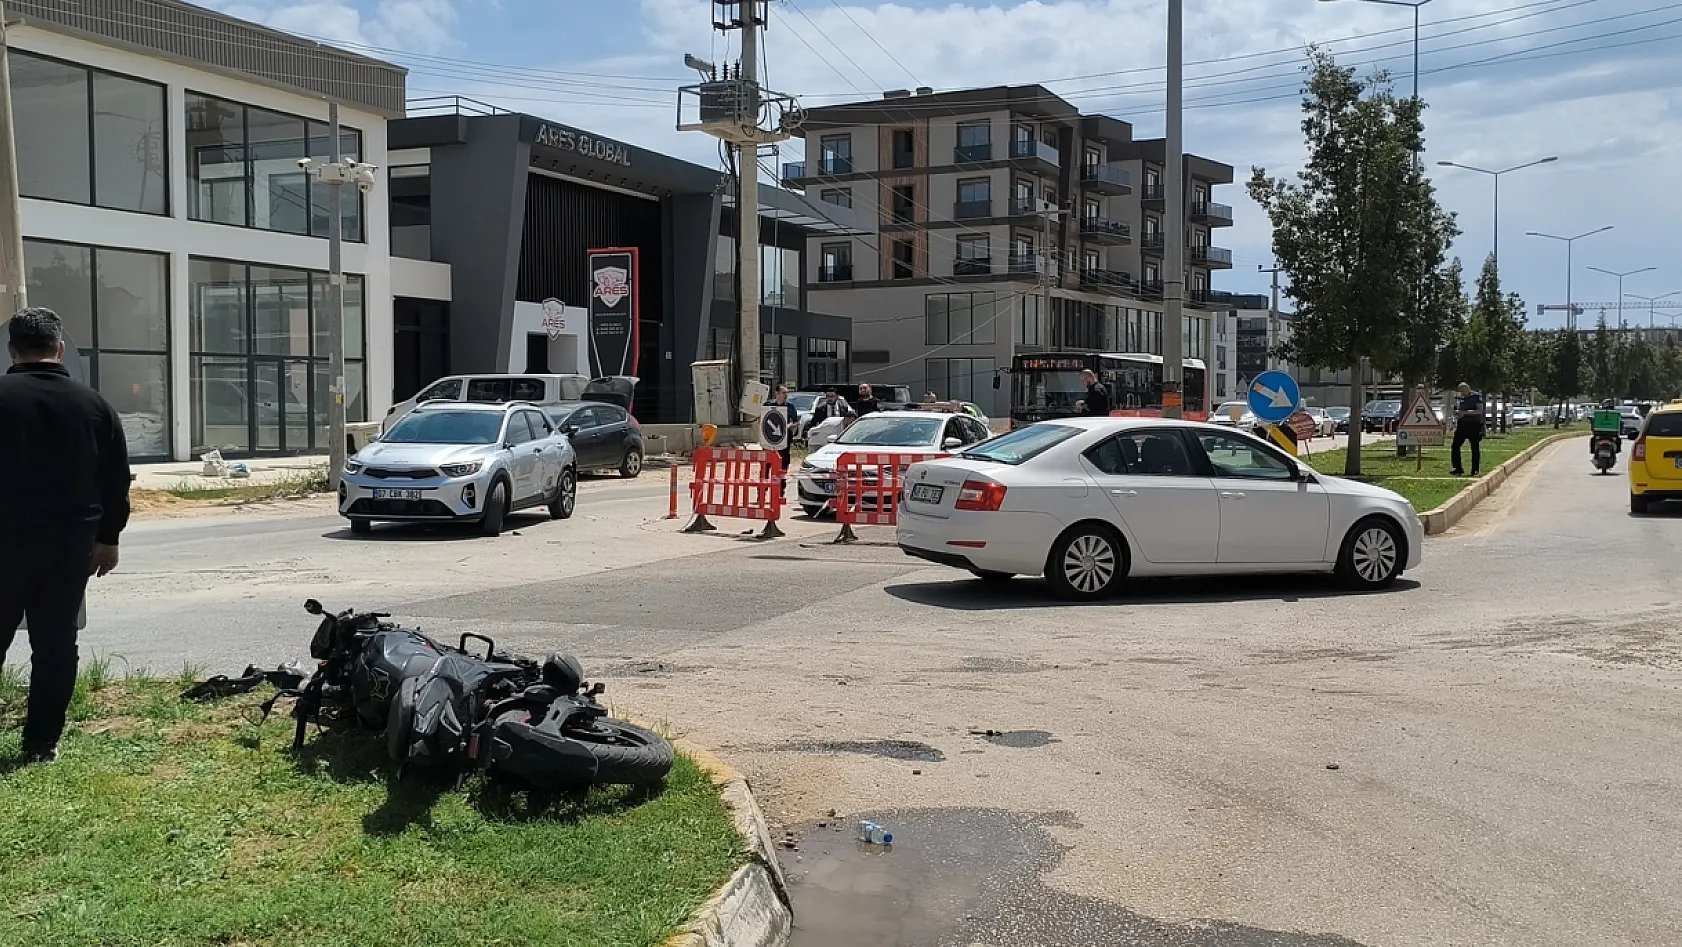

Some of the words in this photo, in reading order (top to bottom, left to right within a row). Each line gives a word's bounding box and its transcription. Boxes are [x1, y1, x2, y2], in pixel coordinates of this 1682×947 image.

[535, 123, 576, 151] ARES
[579, 135, 631, 167] GLOBAL
[595, 286, 628, 296] ARES
[542, 318, 566, 330] ARES
